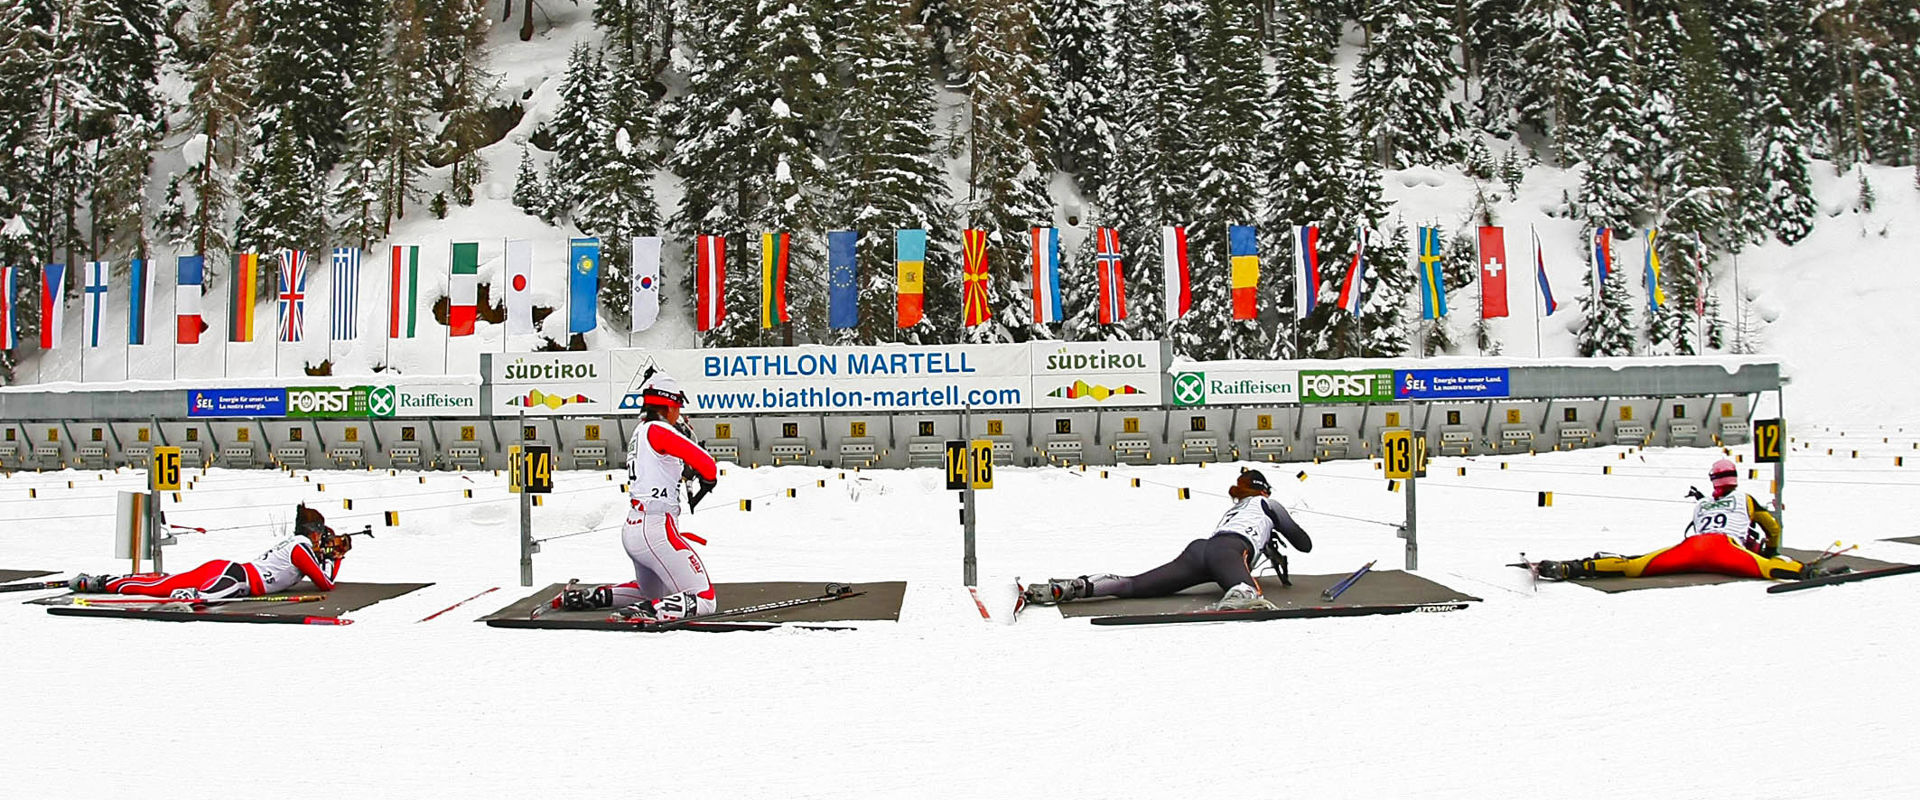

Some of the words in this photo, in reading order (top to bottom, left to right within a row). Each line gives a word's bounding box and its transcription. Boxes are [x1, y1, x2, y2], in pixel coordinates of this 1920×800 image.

[704, 354, 837, 377] BIATHLON
[847, 351, 976, 375] MARTELL
[1210, 379, 1292, 395] Raiffeisen
[1302, 374, 1376, 398] FORST
[1405, 379, 1427, 391] SEL
[1433, 376, 1457, 385] Energie
[288, 390, 353, 413] FORST
[400, 392, 474, 408] Raiffeisen
[697, 384, 1021, 409] www.biathlon-martell.com
[196, 398, 214, 409] SEL
[852, 423, 865, 436] 15
[920, 422, 934, 435] 14
[988, 421, 1002, 434] 13
[1056, 420, 1070, 433] 12
[1125, 419, 1138, 431] 11
[1192, 418, 1206, 430] 10
[290, 428, 302, 440] 24
[345, 428, 357, 440] 23
[402, 428, 415, 440] 22
[461, 427, 474, 439] 21
[586, 426, 599, 438] 19
[717, 425, 730, 437] 17
[784, 425, 798, 437] 16
[1755, 424, 1780, 458] 12
[1385, 437, 1410, 473] 13
[1414, 436, 1425, 471] 12
[155, 453, 179, 485] 15
[525, 452, 550, 487] 14
[947, 446, 968, 483] 14
[971, 446, 992, 484] 13
[651, 487, 668, 499] 24
[1700, 512, 1728, 532] 29
[1245, 526, 1259, 537] 27
[262, 571, 276, 585] 25
[660, 595, 683, 613] 24
[1414, 605, 1458, 614] ATOMIC
